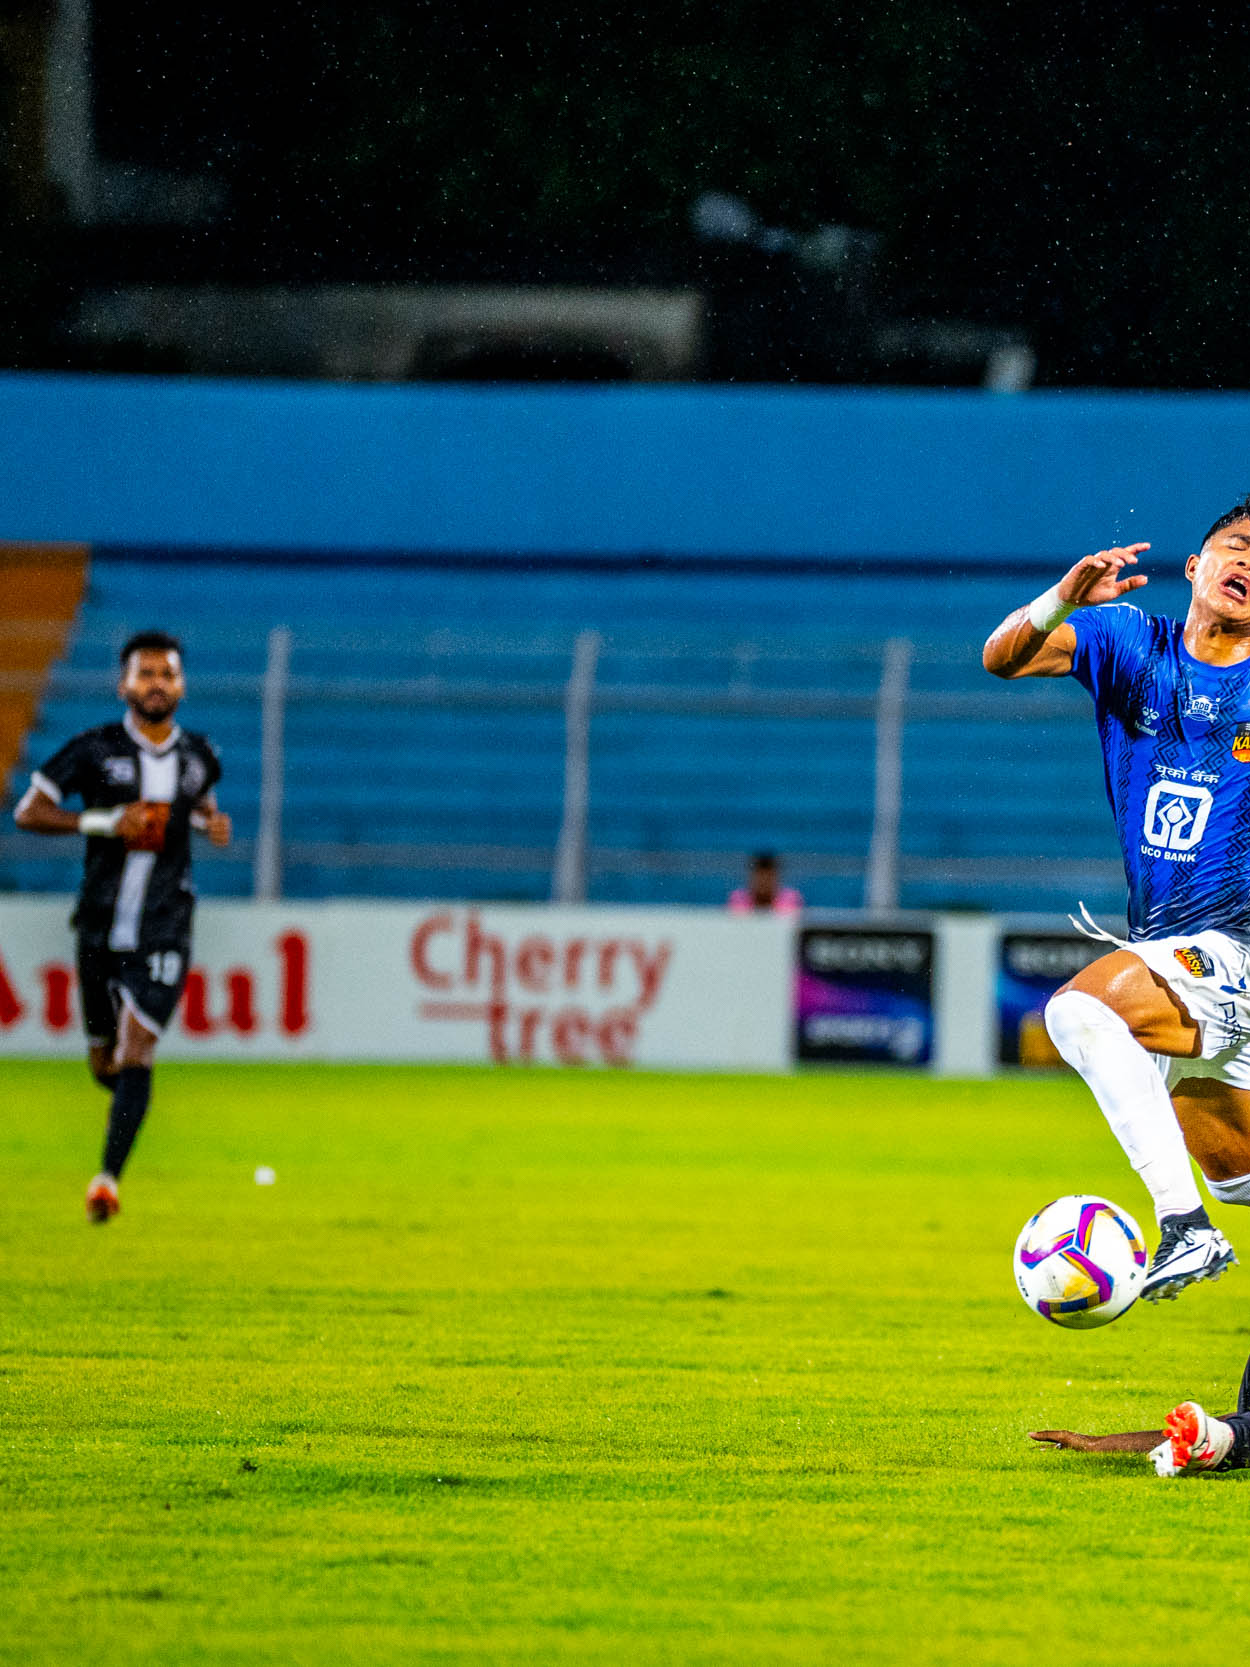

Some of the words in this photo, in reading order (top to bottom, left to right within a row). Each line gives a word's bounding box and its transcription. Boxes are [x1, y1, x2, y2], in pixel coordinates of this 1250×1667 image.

[1141, 845, 1162, 858] UCO
[1164, 851, 1197, 863] BANK
[409, 907, 673, 1010] Cherry
